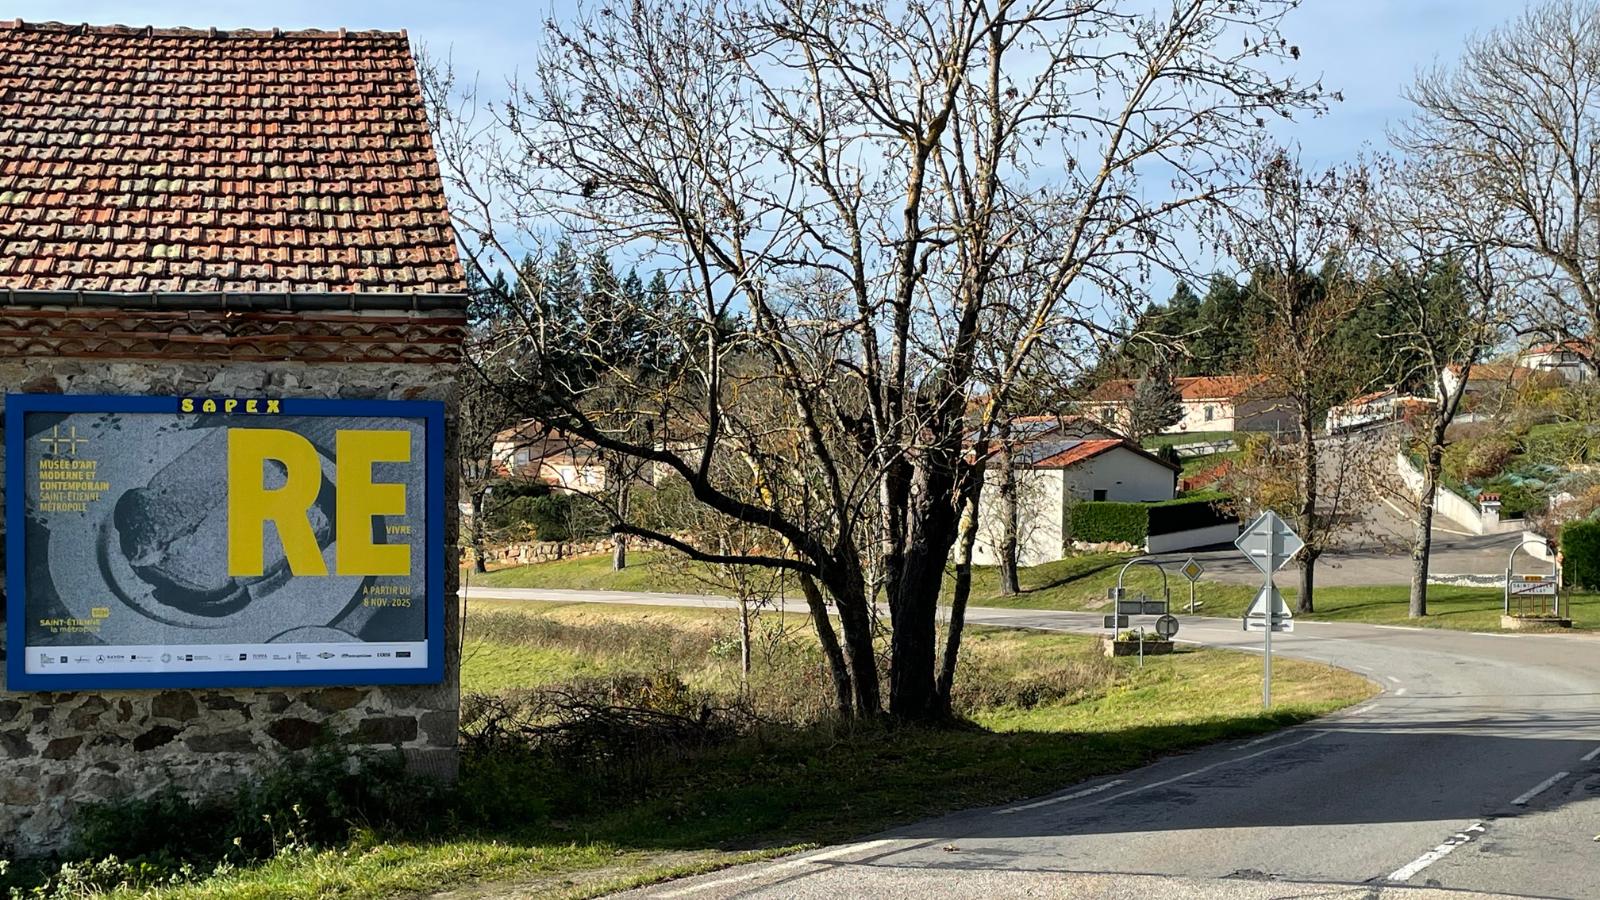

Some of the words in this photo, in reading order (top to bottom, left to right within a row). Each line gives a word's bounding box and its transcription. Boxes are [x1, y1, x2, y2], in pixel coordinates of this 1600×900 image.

[182, 398, 280, 413] SAPEX
[39, 459, 70, 470] MUSÉE
[72, 460, 97, 470] D'ART
[39, 471, 84, 479] MODERNE
[85, 471, 96, 479] ET
[39, 481, 109, 491] CONTEMPORAIN
[39, 490, 100, 502] SAINT-ÉTIENNE
[39, 501, 87, 512] MÉTROPOLE
[228, 428, 411, 576] RE
[386, 525, 411, 534] VIVRE
[370, 586, 398, 595] PARTIR
[400, 586, 411, 595] DU
[363, 597, 369, 607] 8
[371, 598, 390, 607] NOV.
[391, 598, 411, 608] 2025
[39, 618, 101, 626] SAINT-ÉTIENNE
